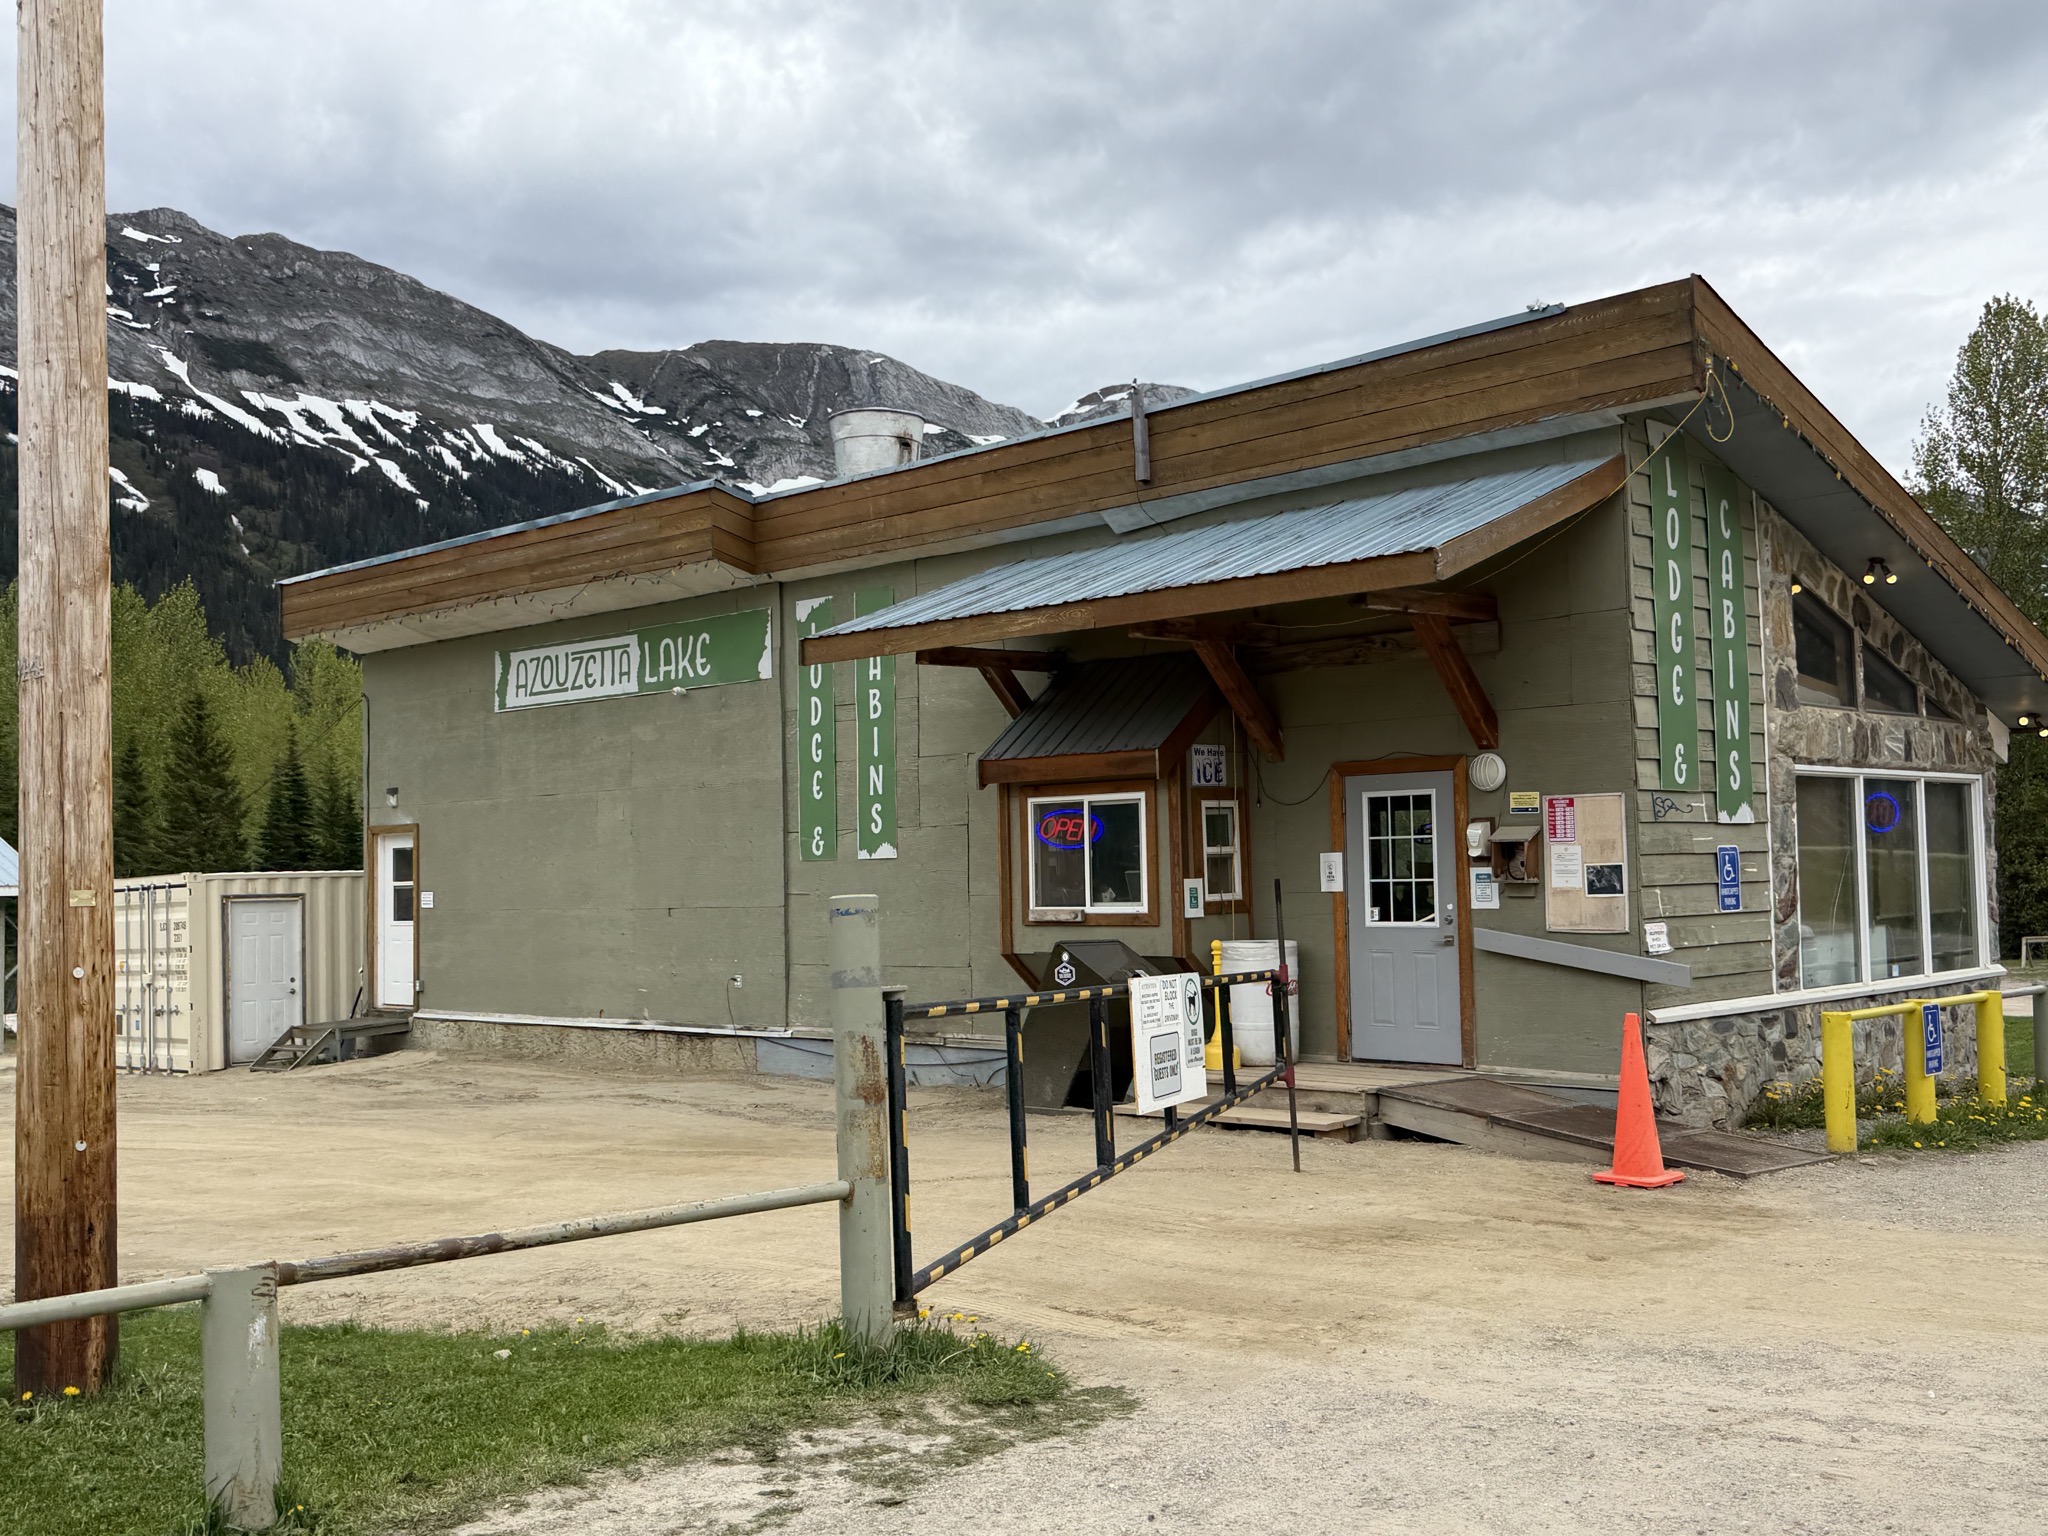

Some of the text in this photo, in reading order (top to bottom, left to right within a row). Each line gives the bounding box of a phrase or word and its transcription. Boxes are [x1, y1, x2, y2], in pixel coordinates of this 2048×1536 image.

[1664, 456, 1687, 785] LODGE &
[1718, 499, 1742, 791] CABINS
[515, 632, 711, 698] AZOUZETTA LAKE
[809, 623, 825, 856] ODGE &
[868, 656, 883, 834] ABINS
[1193, 747, 1225, 757] We Have
[1196, 758, 1224, 784] ICE
[1040, 817, 1097, 841] OPEN
[1164, 991, 1178, 1001] BLOCK
[1169, 979, 1177, 989] NOT
[1154, 1049, 1177, 1065] REGISTERED
[1153, 1062, 1179, 1081] GUESTS ONLY
